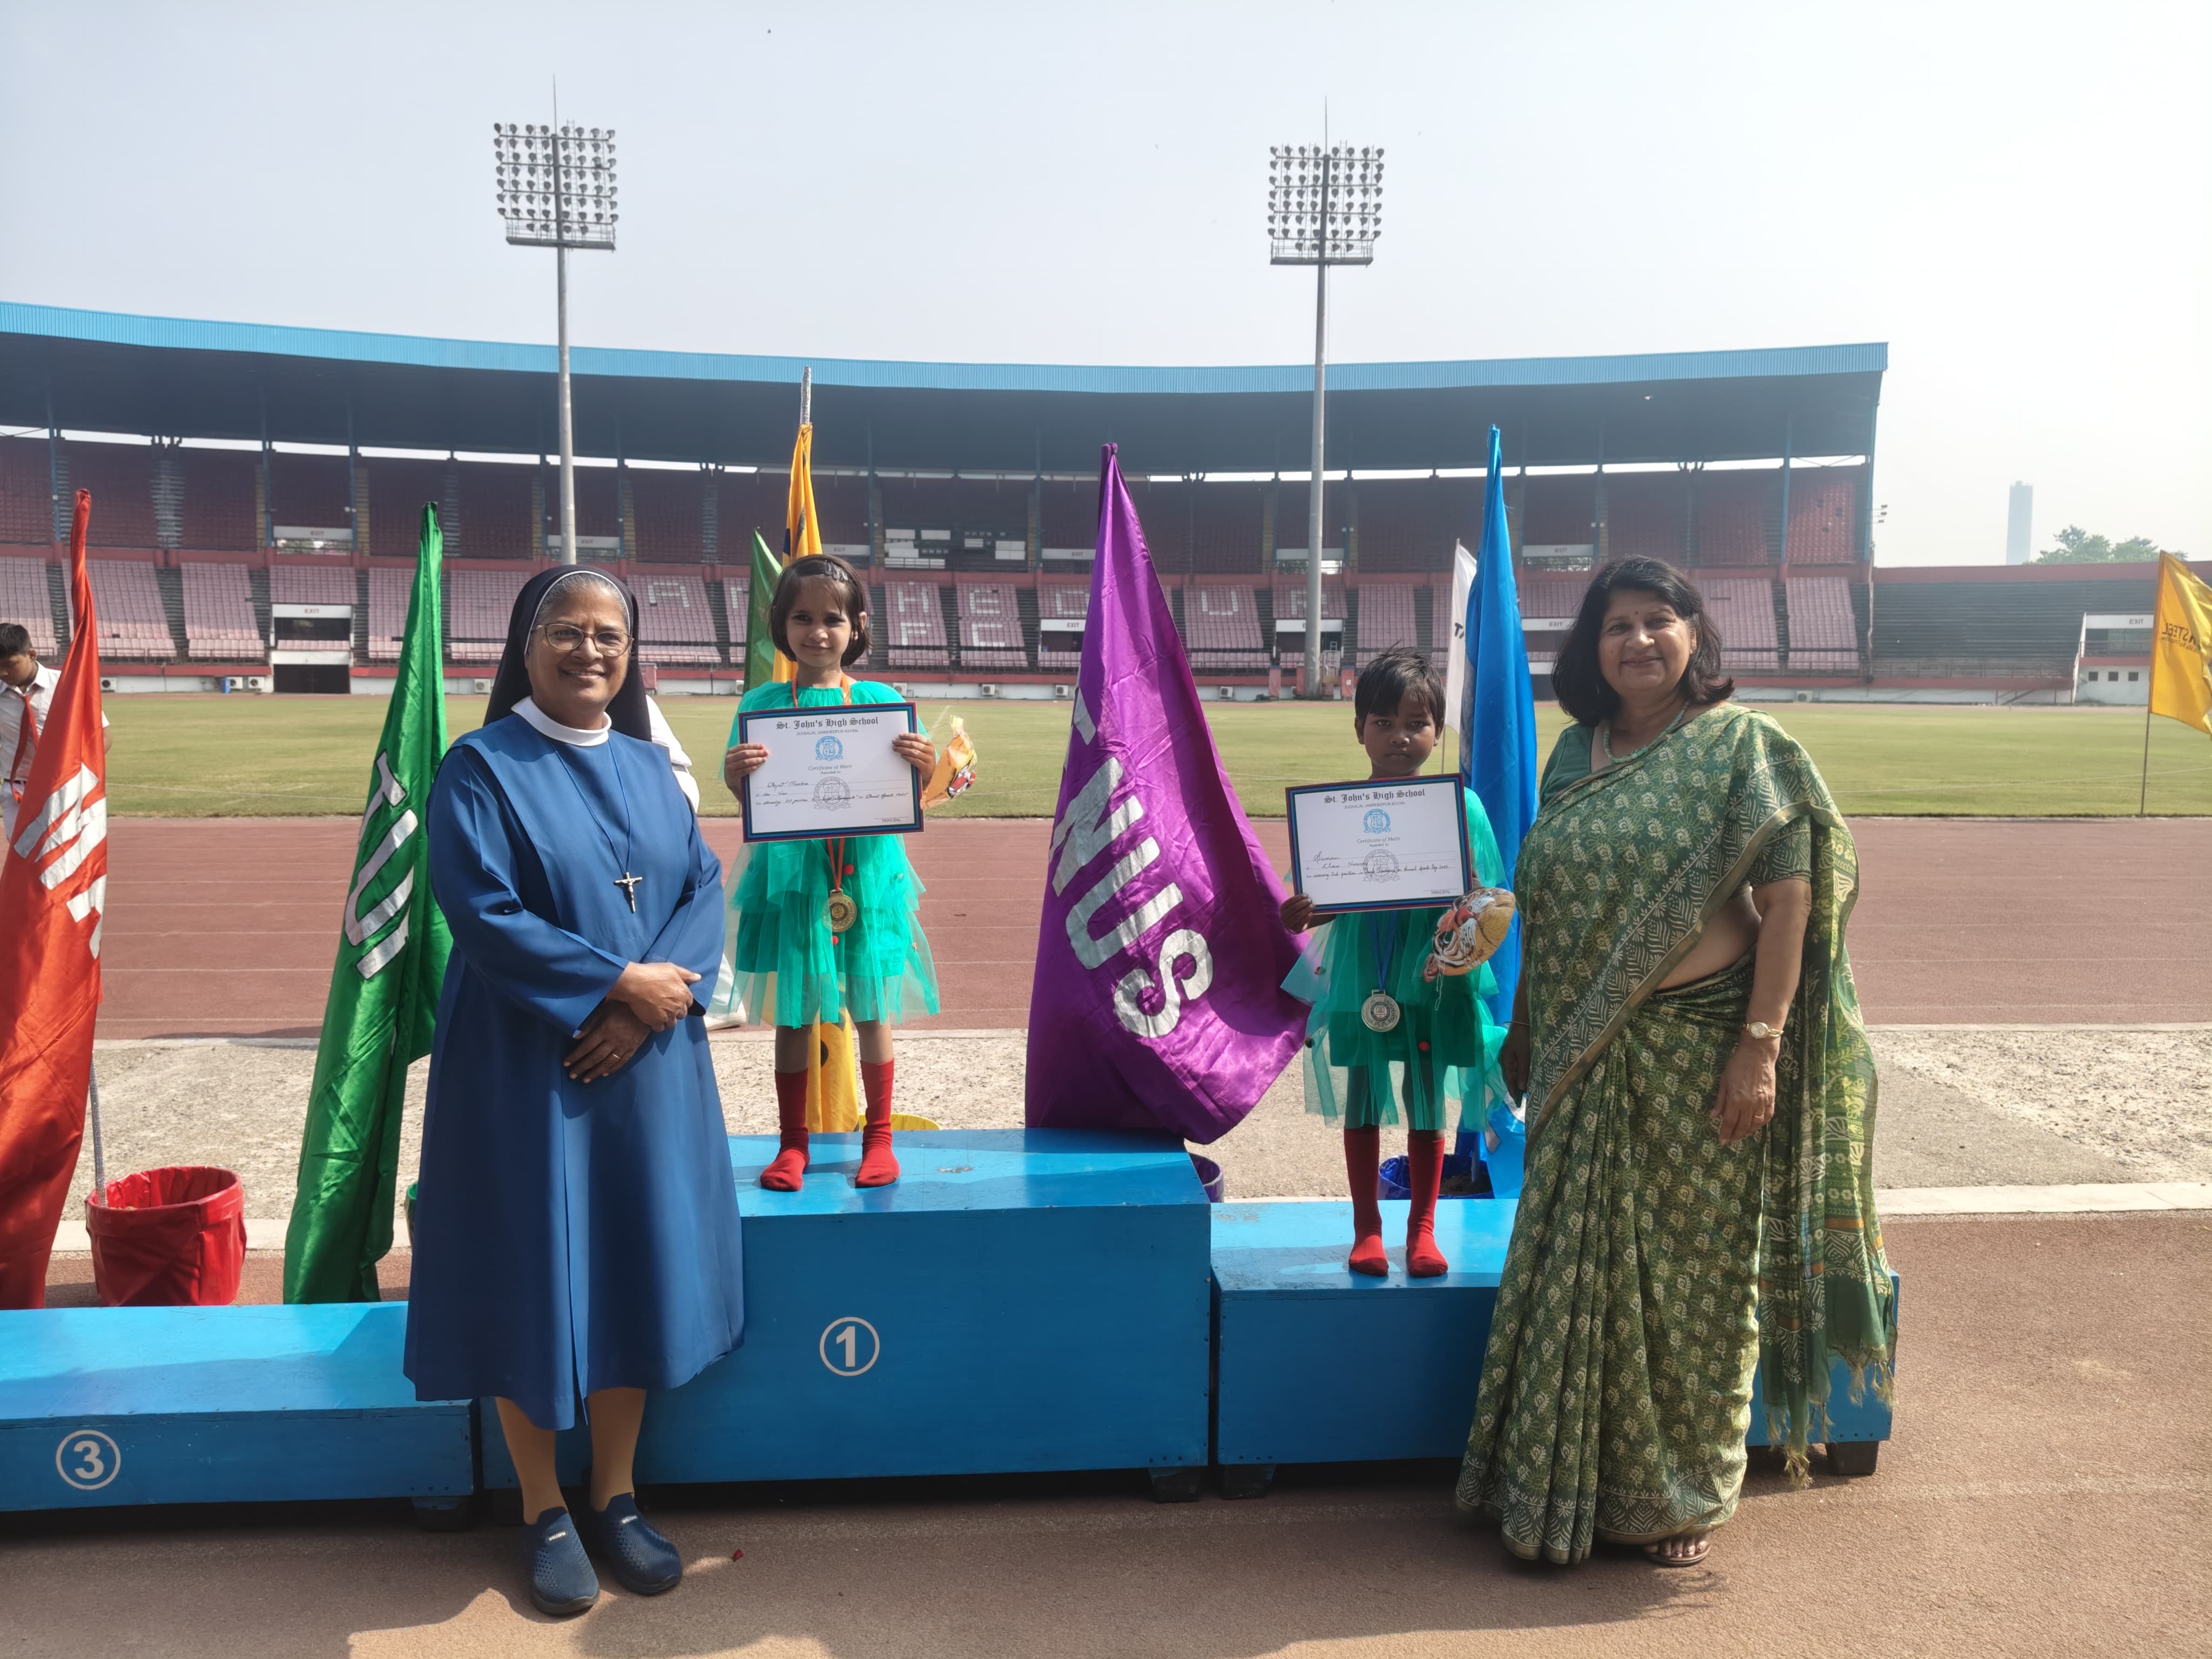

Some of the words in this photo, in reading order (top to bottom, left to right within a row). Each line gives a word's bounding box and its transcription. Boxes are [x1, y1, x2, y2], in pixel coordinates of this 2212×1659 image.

[794, 720, 823, 729] John's
[826, 718, 847, 727] High
[849, 717, 878, 725] School
[1341, 793, 1370, 803] John's
[1373, 791, 1394, 800] High
[1396, 788, 1425, 798] School
[836, 1326, 855, 1367] 1
[74, 1440, 104, 1479] 3
